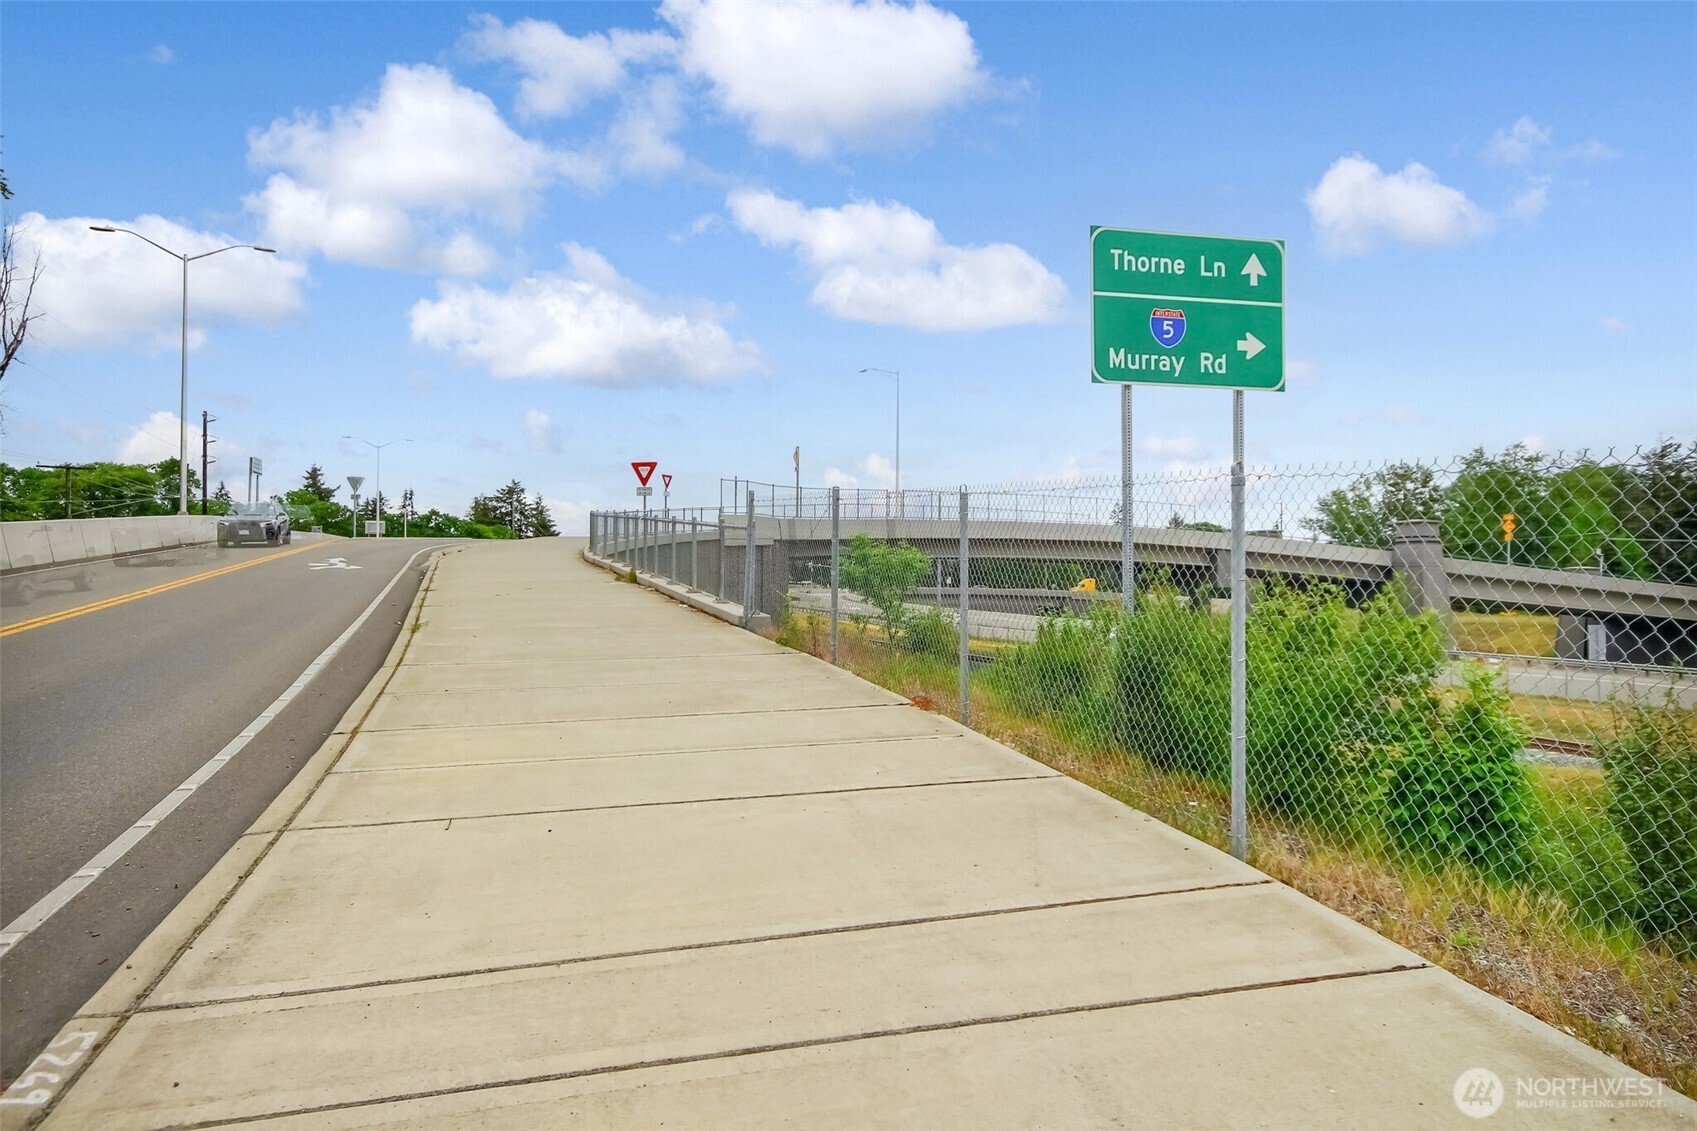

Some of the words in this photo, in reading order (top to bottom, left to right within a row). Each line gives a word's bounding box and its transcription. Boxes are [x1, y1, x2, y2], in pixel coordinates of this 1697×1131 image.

[1110, 248, 1186, 275] Thorne
[1200, 255, 1226, 278] Ln
[1163, 320, 1175, 339] 5
[1109, 347, 1186, 377] Murray
[1200, 352, 1227, 374] Rd
